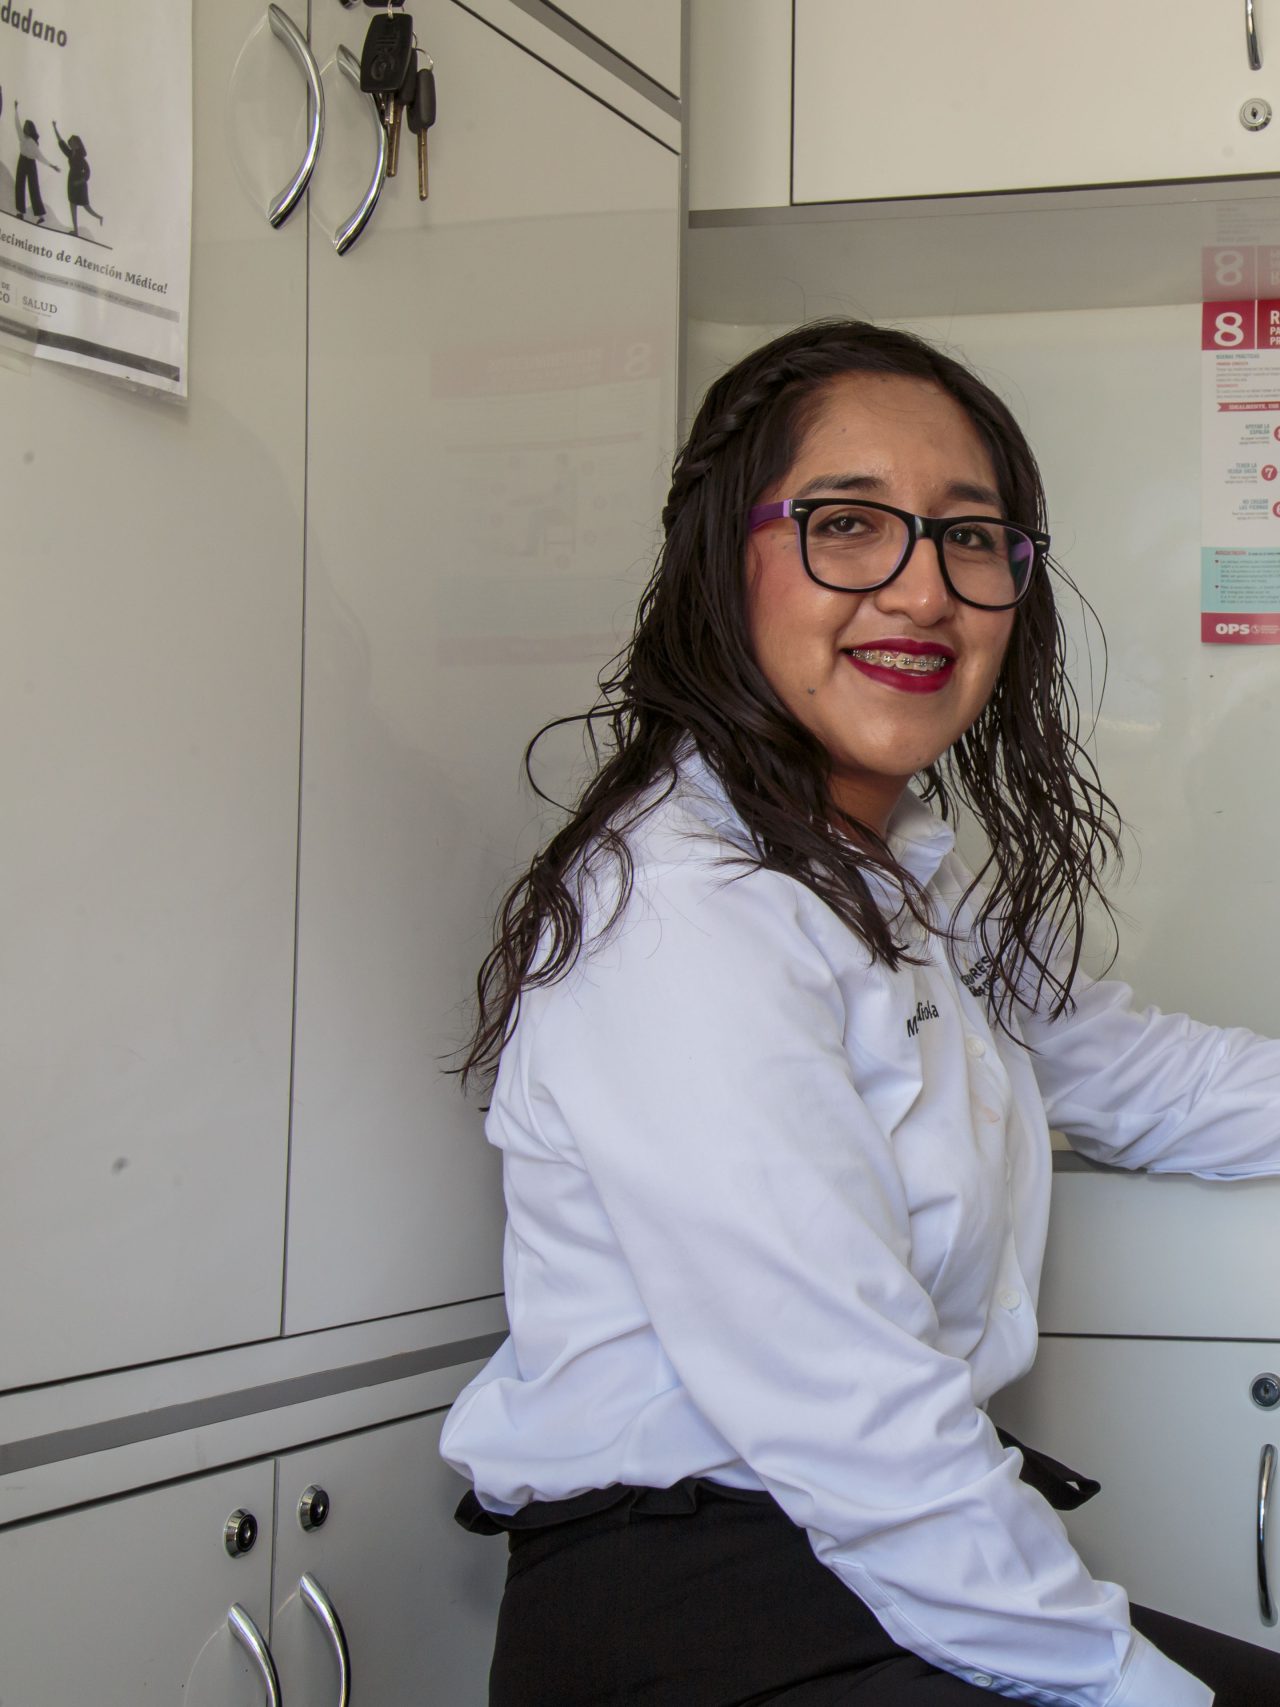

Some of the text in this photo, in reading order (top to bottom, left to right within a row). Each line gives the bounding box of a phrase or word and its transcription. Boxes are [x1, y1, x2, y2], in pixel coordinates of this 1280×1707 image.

[56, 250, 71, 263] de
[74, 256, 122, 280] Atención
[125, 272, 168, 294] Médica!
[2, 282, 10, 290] DE
[22, 296, 57, 313] SALUD
[1214, 312, 1244, 346] 8
[1216, 623, 1250, 635] OPS
